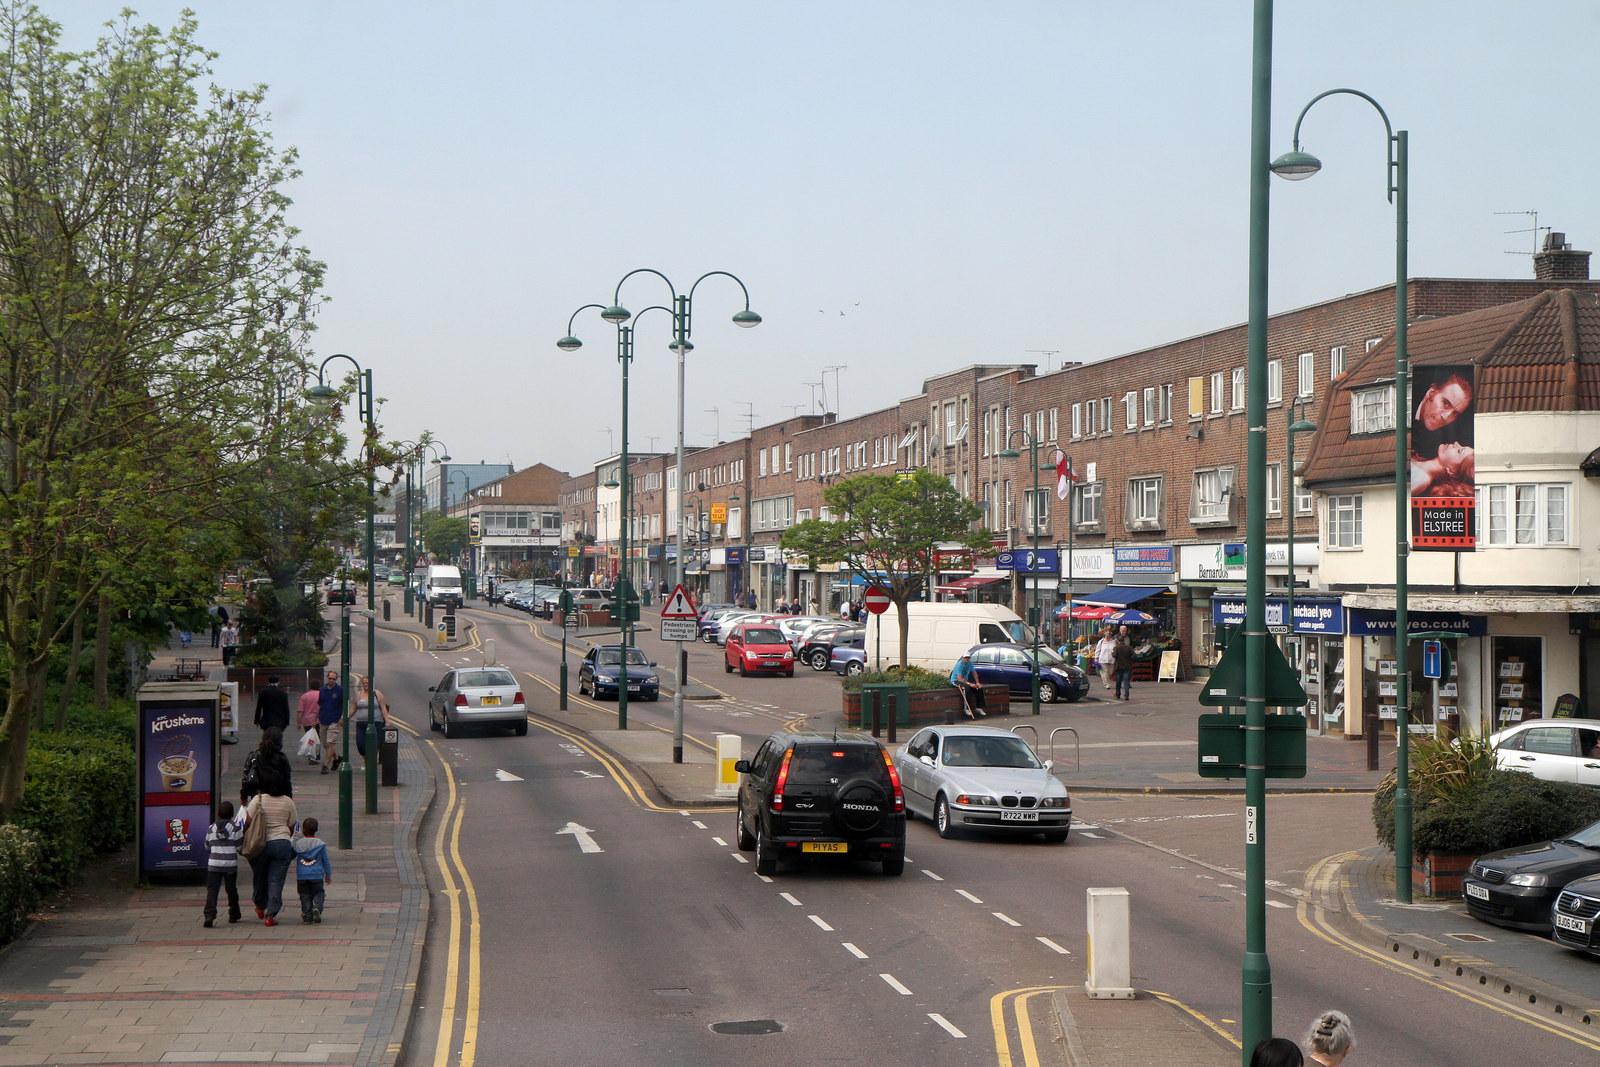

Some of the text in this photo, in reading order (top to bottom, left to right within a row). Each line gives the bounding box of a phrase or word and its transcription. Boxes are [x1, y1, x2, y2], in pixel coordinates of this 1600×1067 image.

[1424, 510, 1464, 519] Made in
[1424, 521, 1464, 532] ELSTREE
[1150, 549, 1170, 560] MARKET
[1221, 602, 1244, 614] michael
[1319, 608, 1332, 621] yeo
[842, 804, 880, 812] HONDA
[172, 844, 190, 852] good
[822, 844, 838, 852] YAS
